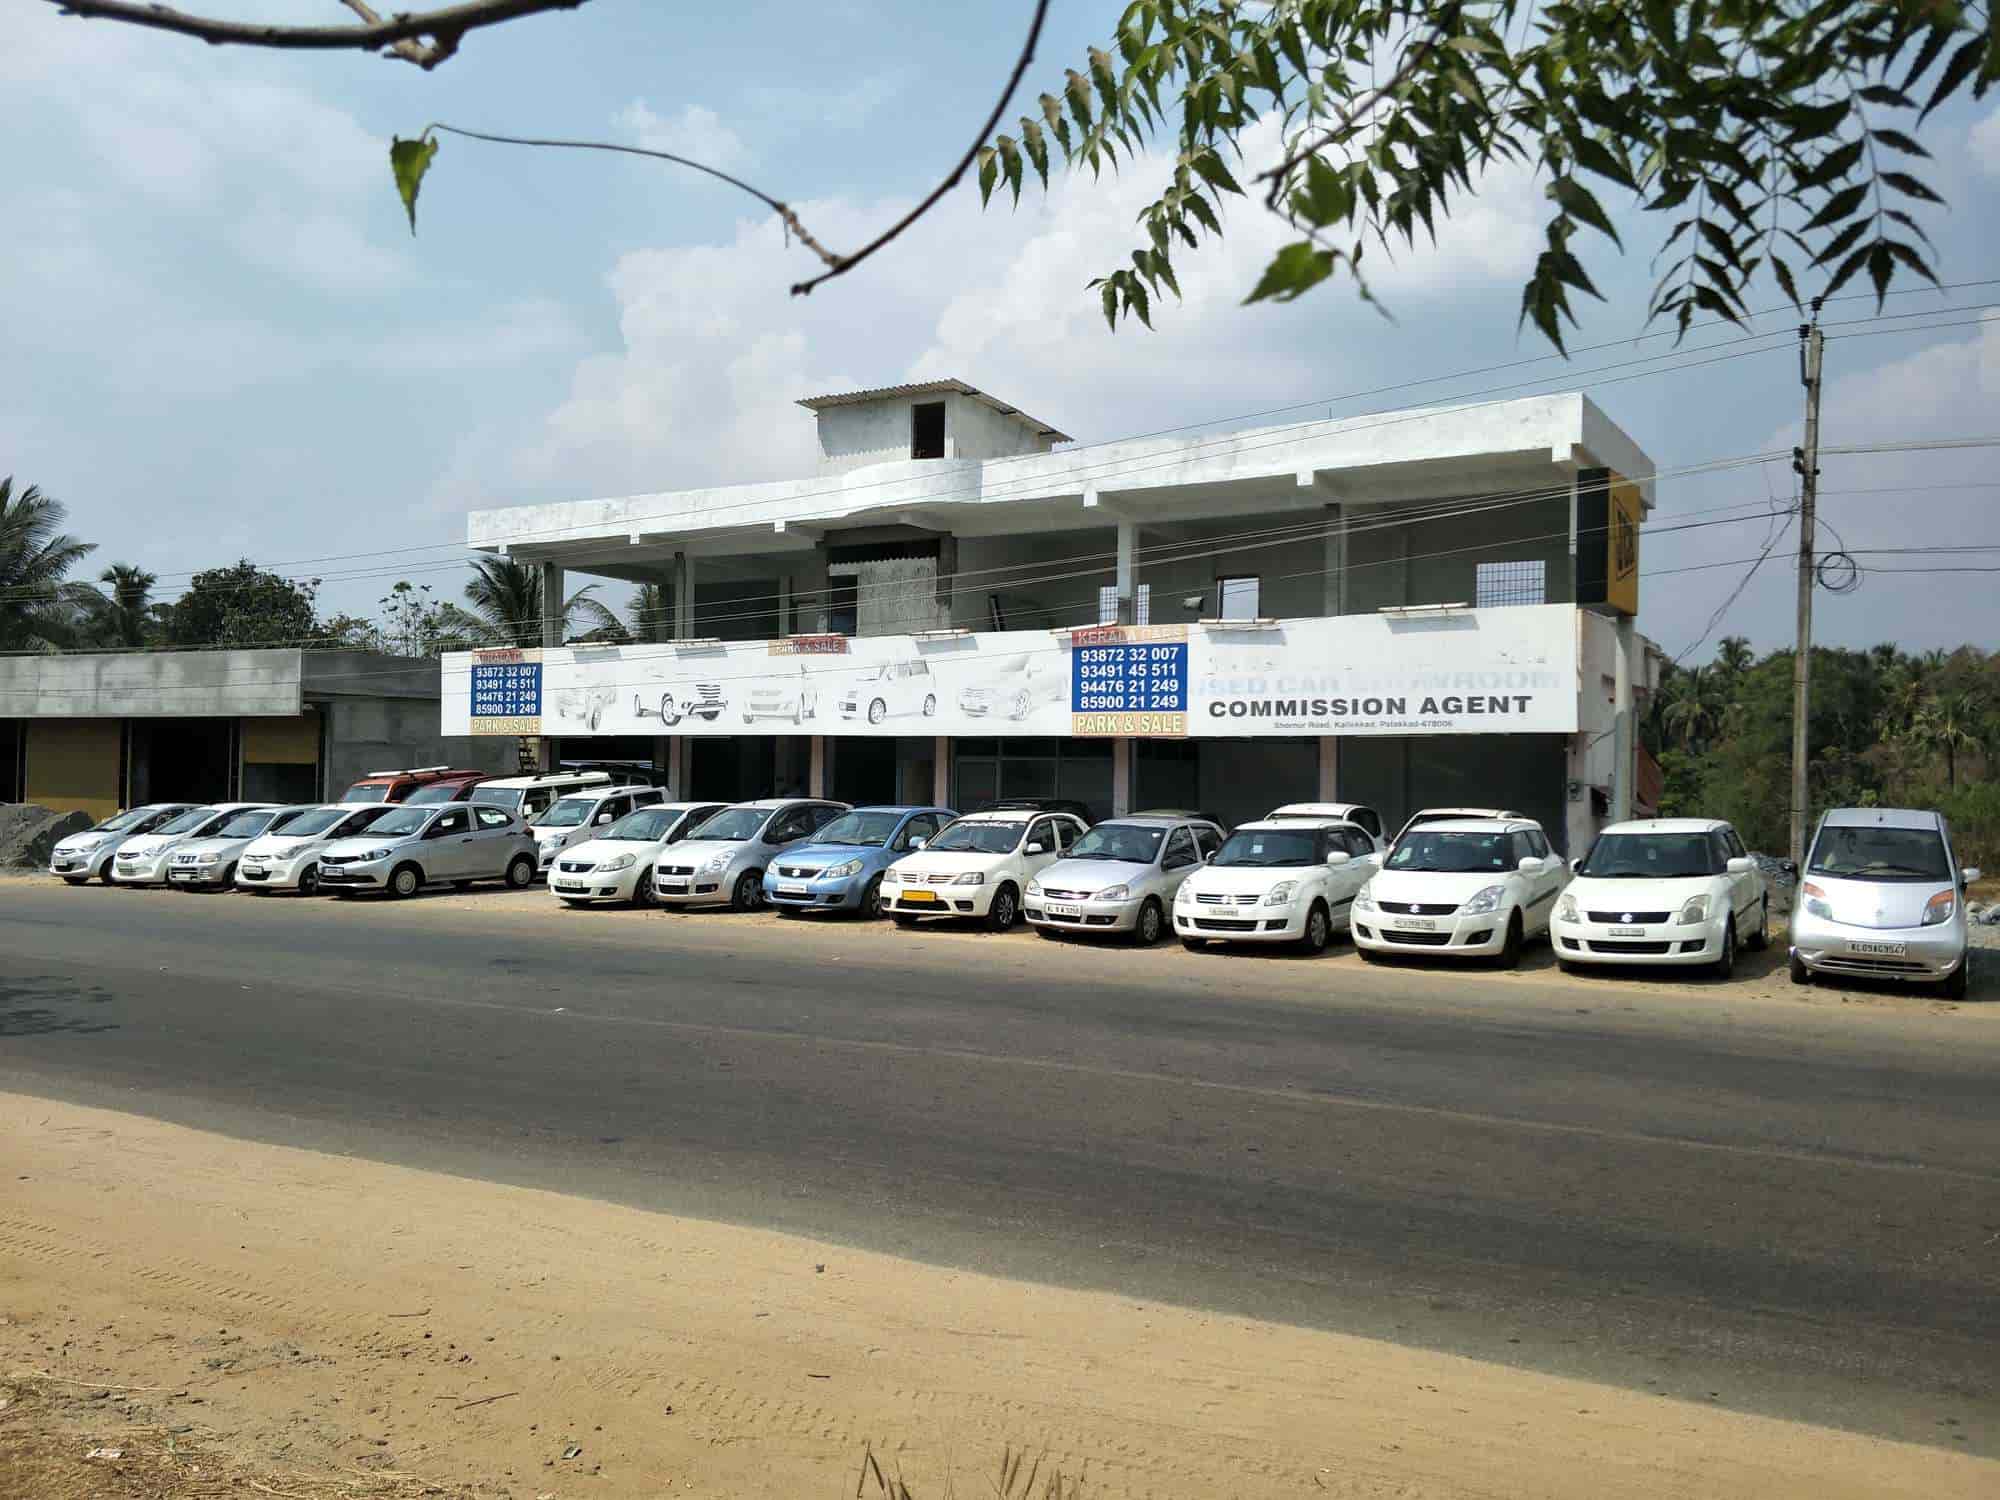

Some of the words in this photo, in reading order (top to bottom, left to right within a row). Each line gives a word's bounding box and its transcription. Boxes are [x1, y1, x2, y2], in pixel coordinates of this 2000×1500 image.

[1081, 649, 1125, 662] 93872
[1129, 648, 1147, 661] 32
[1151, 647, 1179, 660] 007
[506, 666, 518, 677] 32
[520, 666, 537, 676] 007
[1080, 664, 1123, 678] 93491
[1128, 663, 1147, 676] 45
[1151, 663, 1176, 676] 511
[505, 679, 518, 689] 45
[520, 678, 536, 689] 511
[1080, 680, 1124, 693] 94476
[1128, 680, 1145, 693] 21
[1151, 679, 1179, 692] 249
[506, 691, 516, 701] 21
[519, 690, 537, 701] 249
[1080, 696, 1124, 709] 85900
[1128, 696, 1145, 708] 21
[1151, 695, 1179, 708] 249
[505, 703, 516, 713] 21
[519, 703, 537, 714] 249
[1208, 697, 1406, 717] COMMISSION
[1418, 695, 1533, 715] AGENT
[1077, 716, 1118, 732] PARK
[1124, 716, 1134, 732] &
[1142, 715, 1181, 732] SALE
